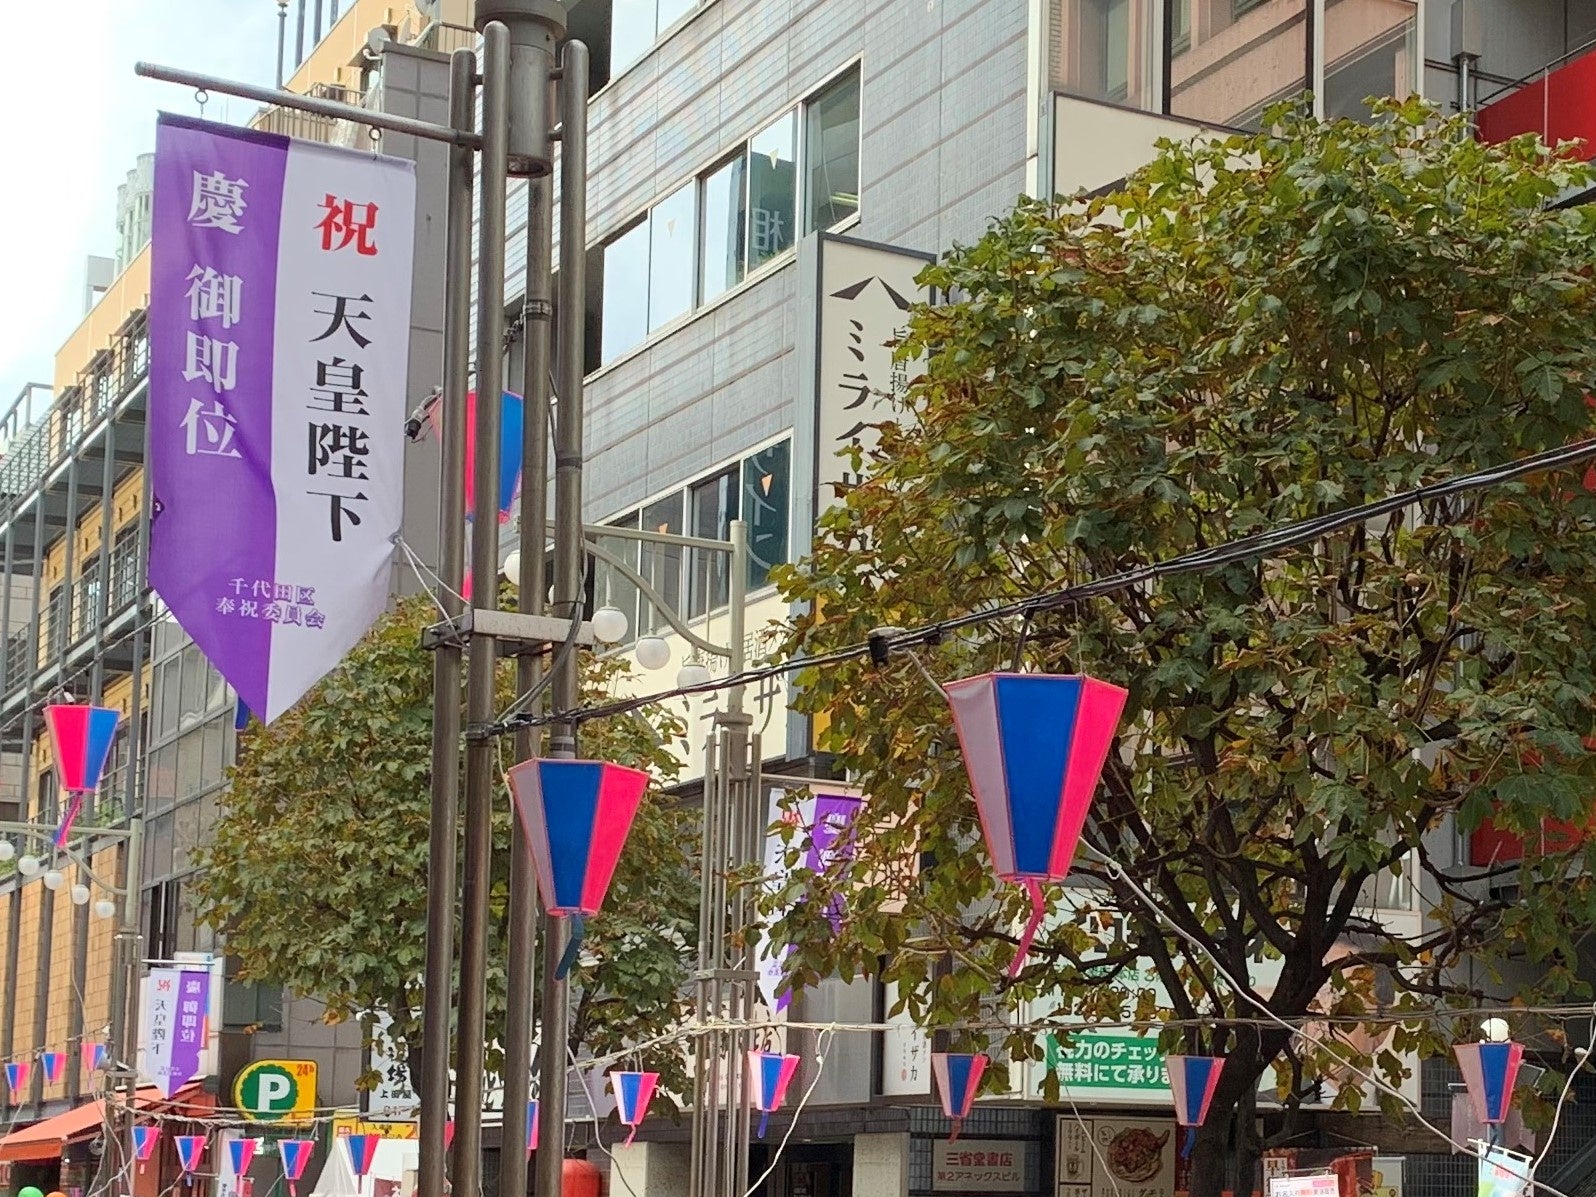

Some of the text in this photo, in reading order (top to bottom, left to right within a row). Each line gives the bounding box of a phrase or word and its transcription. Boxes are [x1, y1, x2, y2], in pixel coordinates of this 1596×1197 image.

[179, 170, 250, 459] 慶 御即位
[306, 193, 379, 542] 祝 天皇陛下
[228, 578, 316, 606] 千代田区
[216, 597, 326, 630] 奉祝委員会
[946, 1152, 1013, 1167] 三省堂書店
[937, 1171, 1020, 1182] 第2アネックスビル
